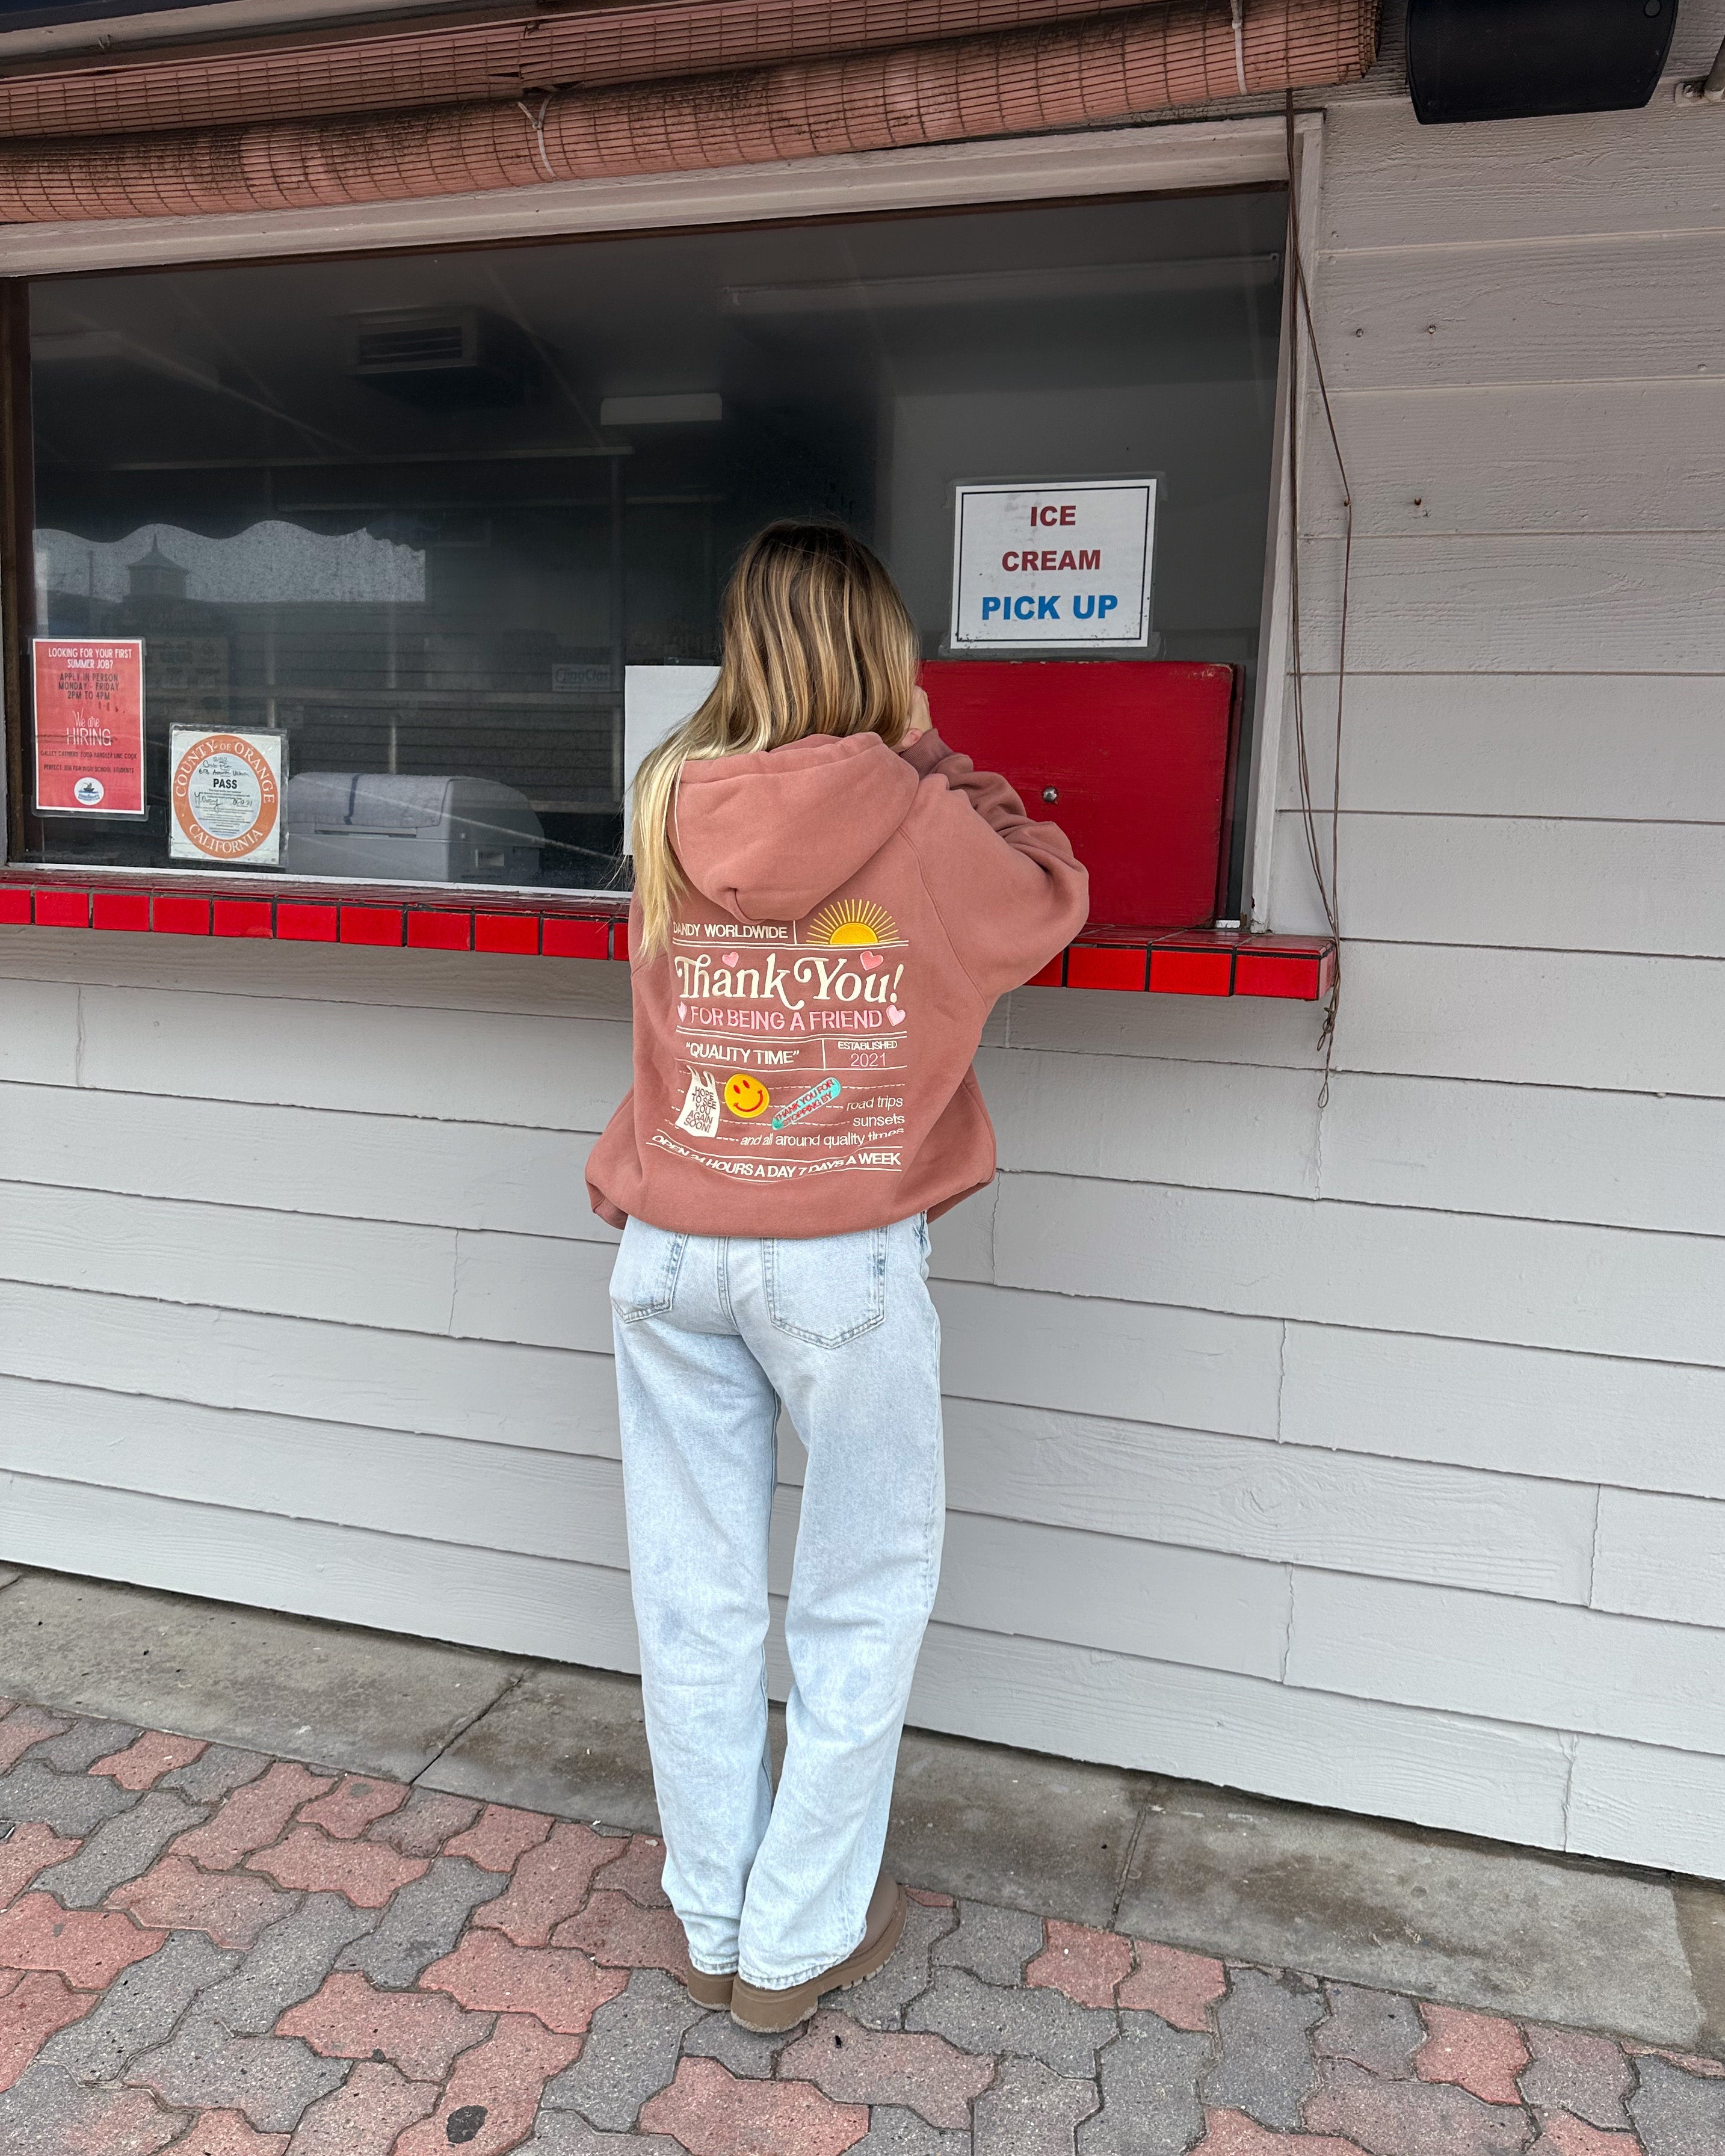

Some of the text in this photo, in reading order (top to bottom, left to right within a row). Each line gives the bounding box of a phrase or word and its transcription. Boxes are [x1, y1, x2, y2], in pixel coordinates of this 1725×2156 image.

[1030, 505, 1076, 526] ICE
[1002, 549, 1100, 571] CREAM
[982, 595, 1118, 620] PICK UP
[48, 648, 132, 658] LOOKING FOR YOUR FIRST
[67, 659, 114, 668] SUMMER JOB?
[60, 673, 79, 681] APPLY
[58, 682, 87, 690] MONDAY
[96, 682, 119, 691] FRIDAY
[96, 692, 110, 700] 4PM
[72, 707, 100, 727] We are
[66, 727, 111, 746] HIRING
[176, 740, 275, 803] COUNTY OF ORANGE
[213, 778, 238, 789] PASS
[189, 824, 264, 853] CALIFORNIA
[673, 921, 788, 939] DANDY WORLDWIDE
[674, 953, 904, 1010] Thank You!
[690, 1006, 883, 1031] FOR BEING A FRIEND
[686, 1042, 800, 1065] "QUALITY TIME"
[838, 1041, 897, 1050] ESTABLISHED
[851, 1052, 886, 1067] 2021
[692, 1093, 717, 1109] TO SEE
[695, 1086, 714, 1101] HOPE
[776, 1079, 835, 1121] THANK YOU FOR
[821, 1091, 832, 1103] BY
[695, 1103, 711, 1115] YOU
[847, 1095, 903, 1111] road trips
[688, 1110, 714, 1124] AGAIN
[853, 1113, 905, 1127] sunsets
[740, 1128, 904, 1148] and all around quality times
[652, 1135, 901, 1177] OPEN 24 HOURS A DAY 7 DAYS A WEEK
